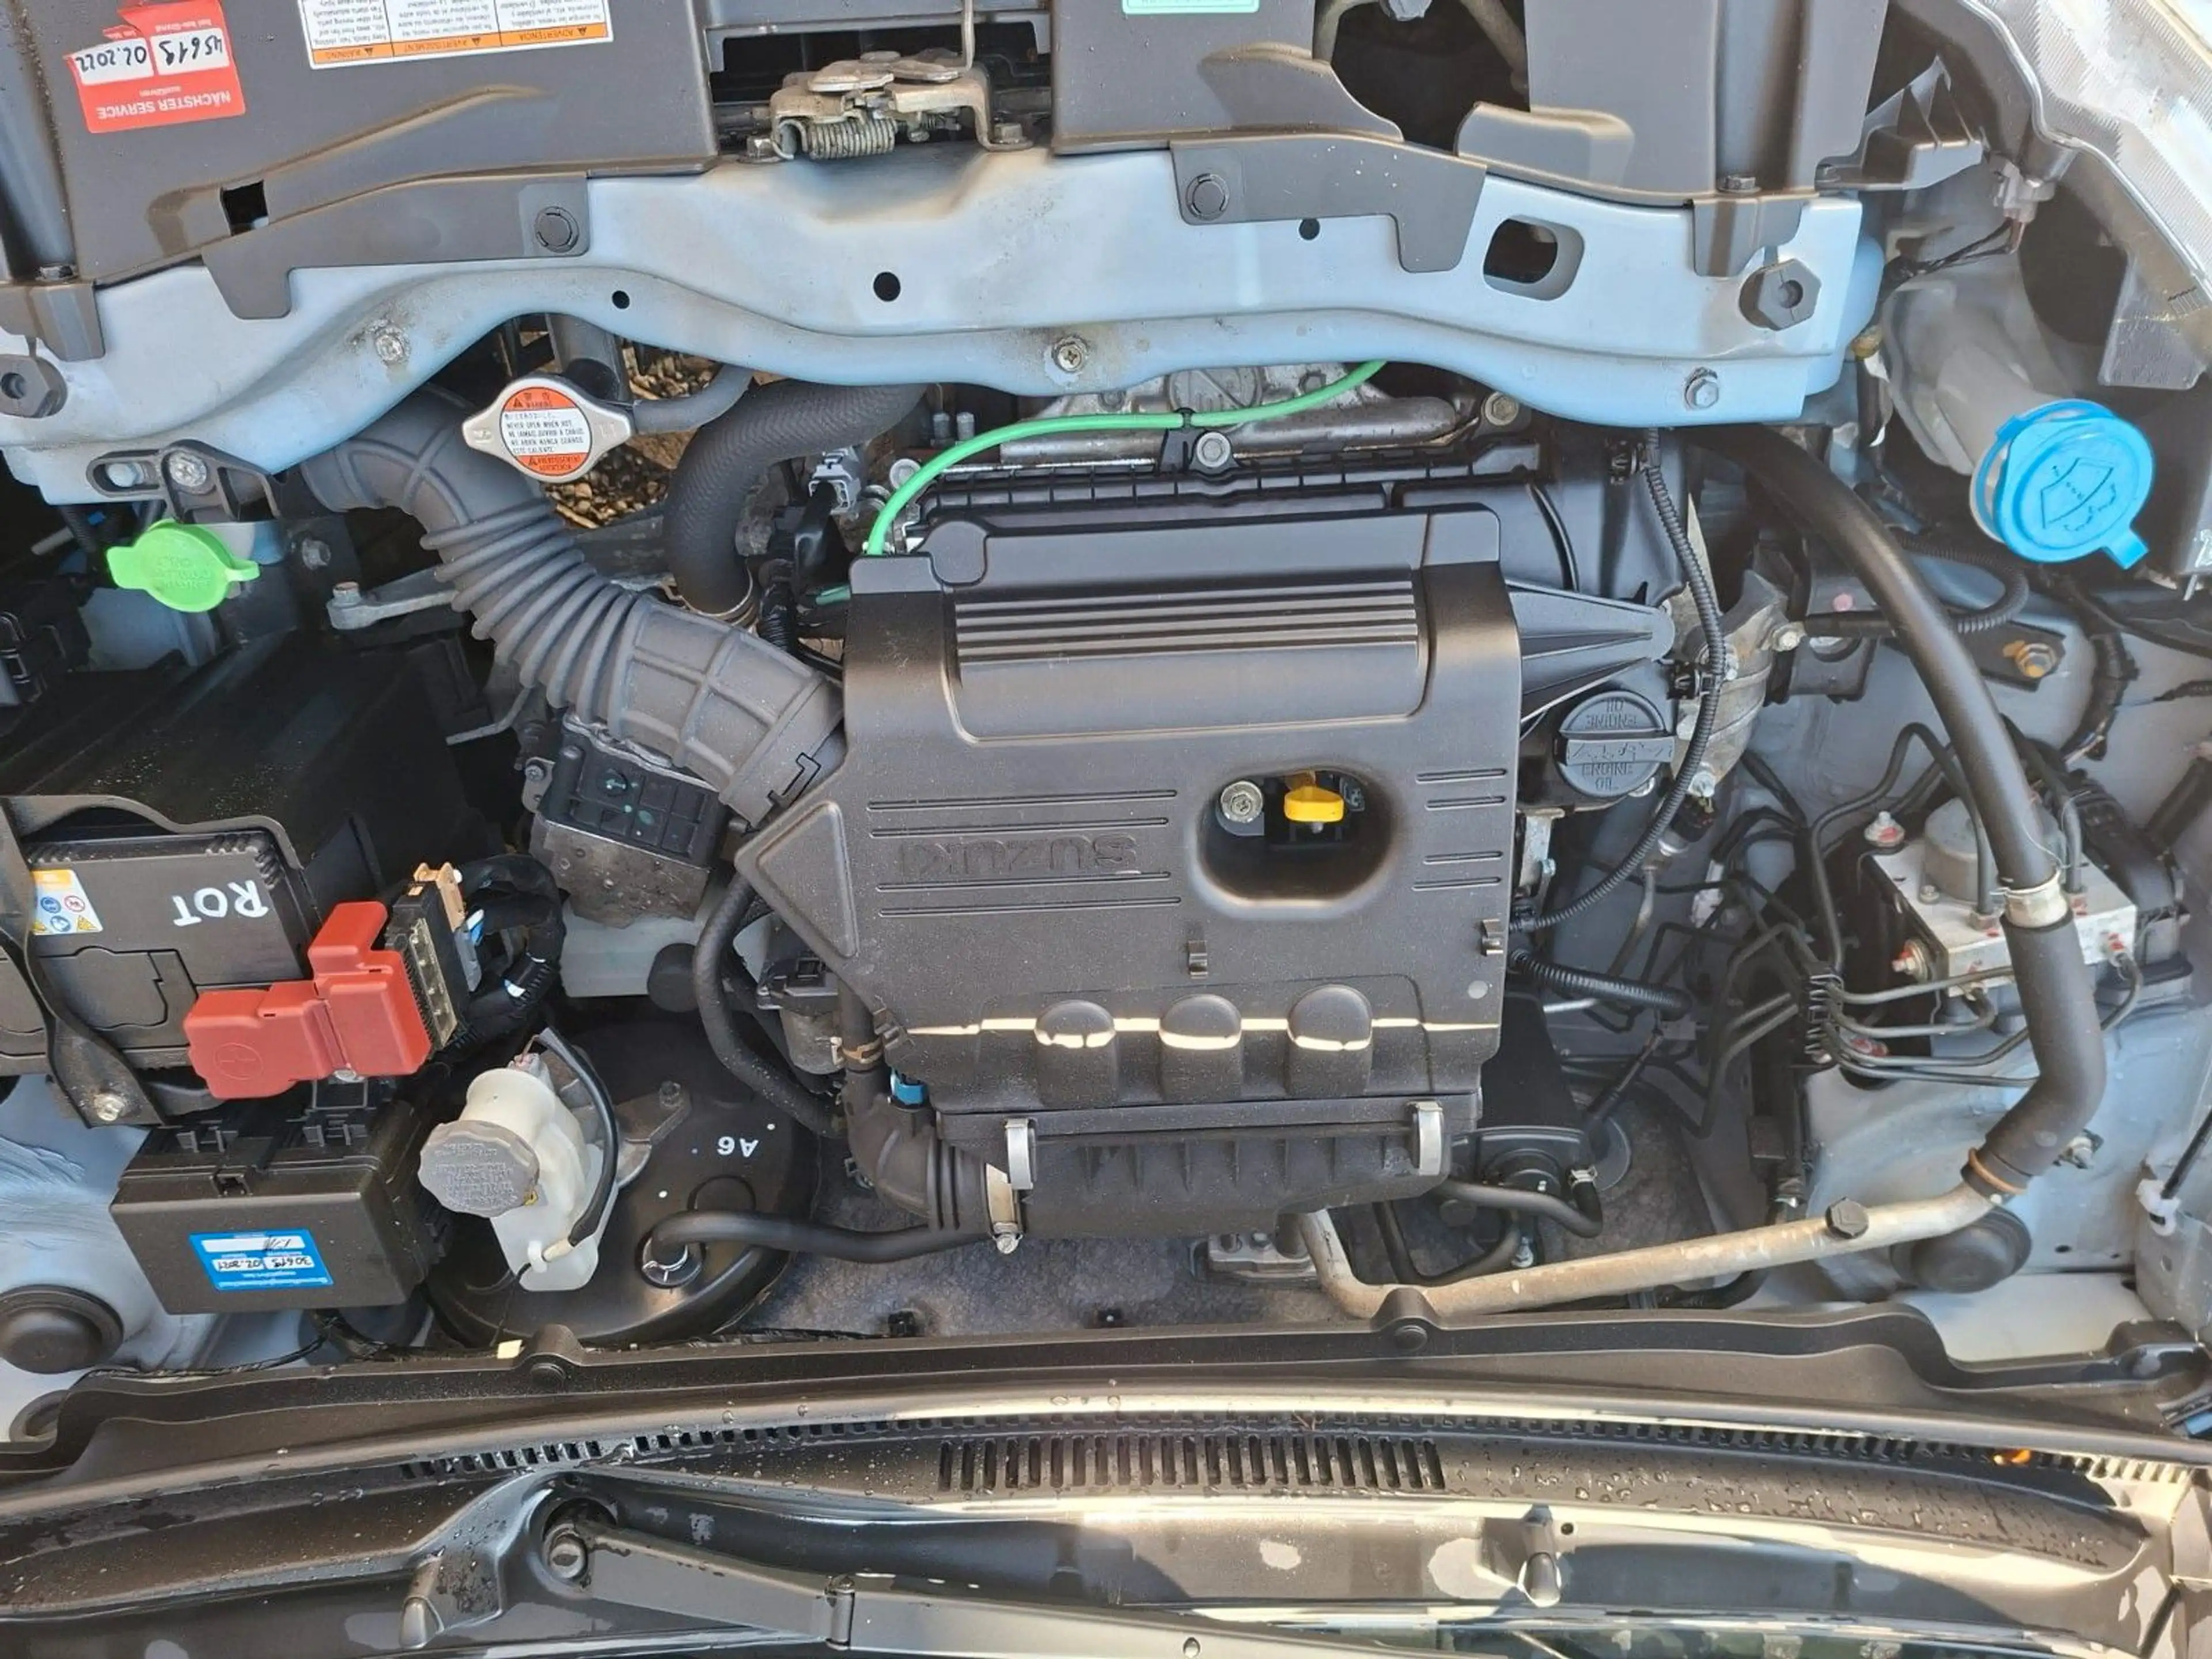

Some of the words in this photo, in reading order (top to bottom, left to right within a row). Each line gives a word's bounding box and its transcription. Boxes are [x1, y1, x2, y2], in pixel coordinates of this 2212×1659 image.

[74, 46, 147, 73] 02.2022
[96, 100, 156, 119] SERVICE
[158, 90, 231, 112] NÄCHSTER
[899, 834, 1137, 876] SUZUKI
[172, 880, 270, 927] ROT
[717, 1136, 759, 1158] A6
